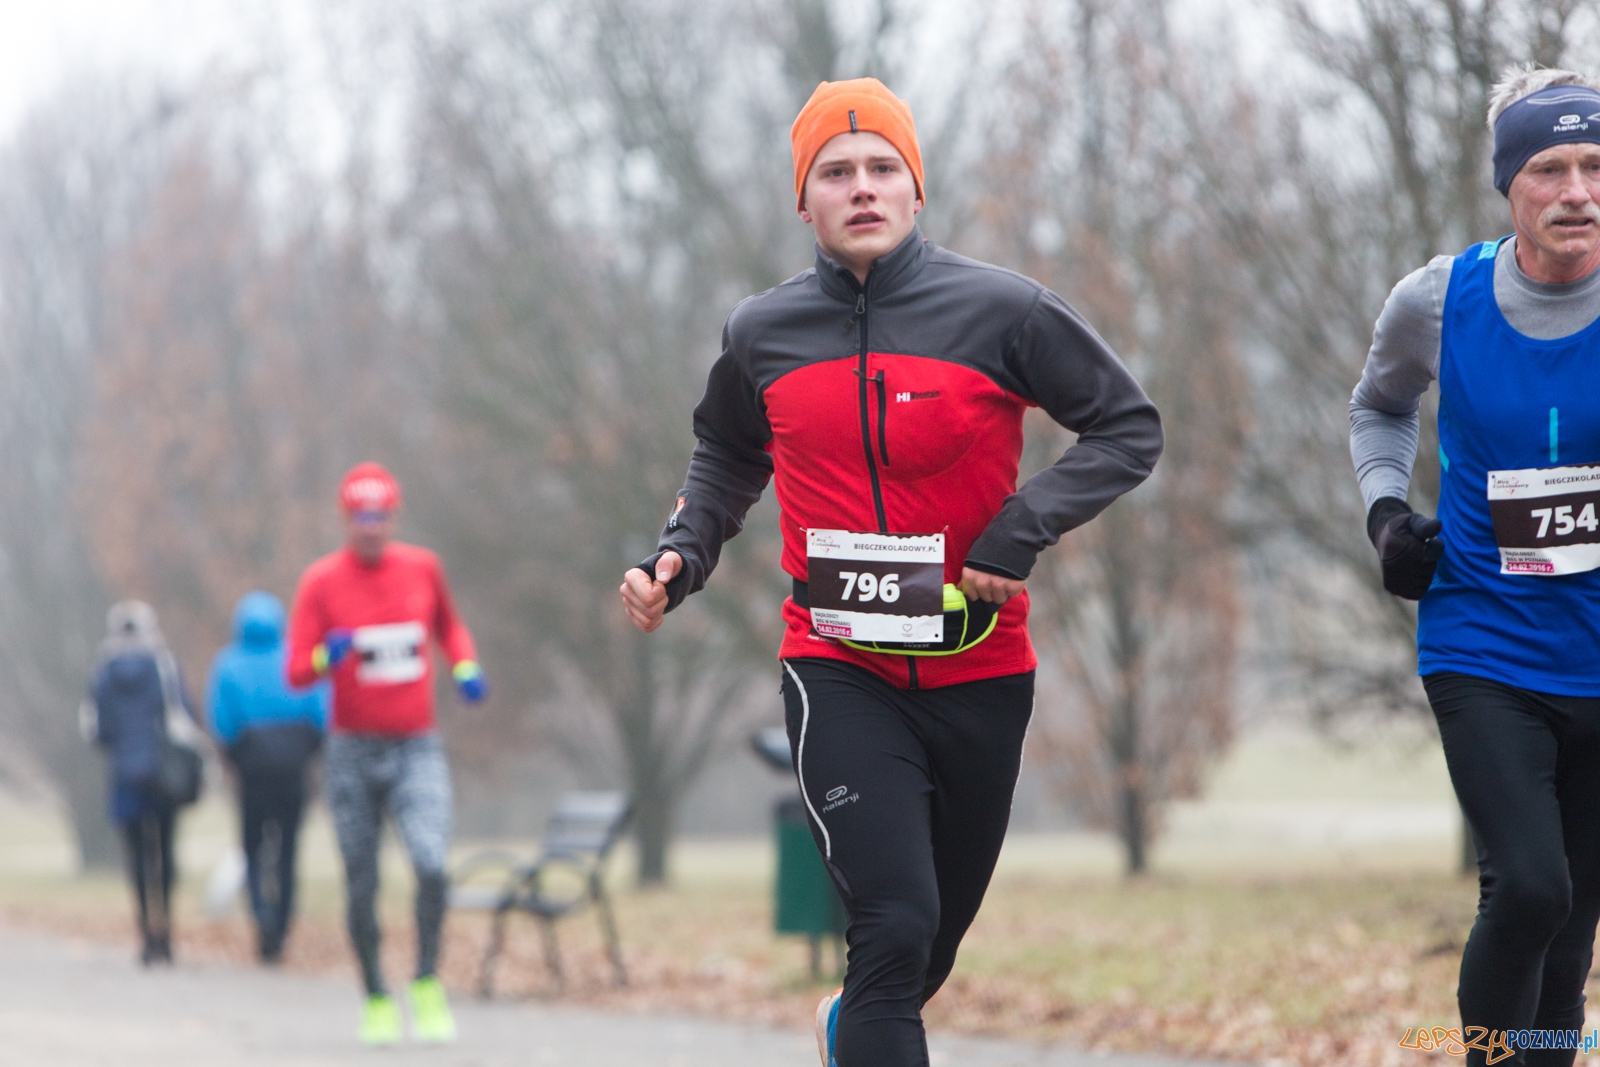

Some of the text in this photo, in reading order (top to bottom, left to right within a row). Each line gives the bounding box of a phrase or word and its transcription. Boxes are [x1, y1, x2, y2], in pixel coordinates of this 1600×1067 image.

[1531, 503, 1598, 538] 754
[854, 544, 936, 552] BIEGCZEKOLADOWY.PL
[1508, 563, 1546, 572] 14.02.2016
[839, 572, 900, 602] 796
[822, 792, 860, 814] Kalenji
